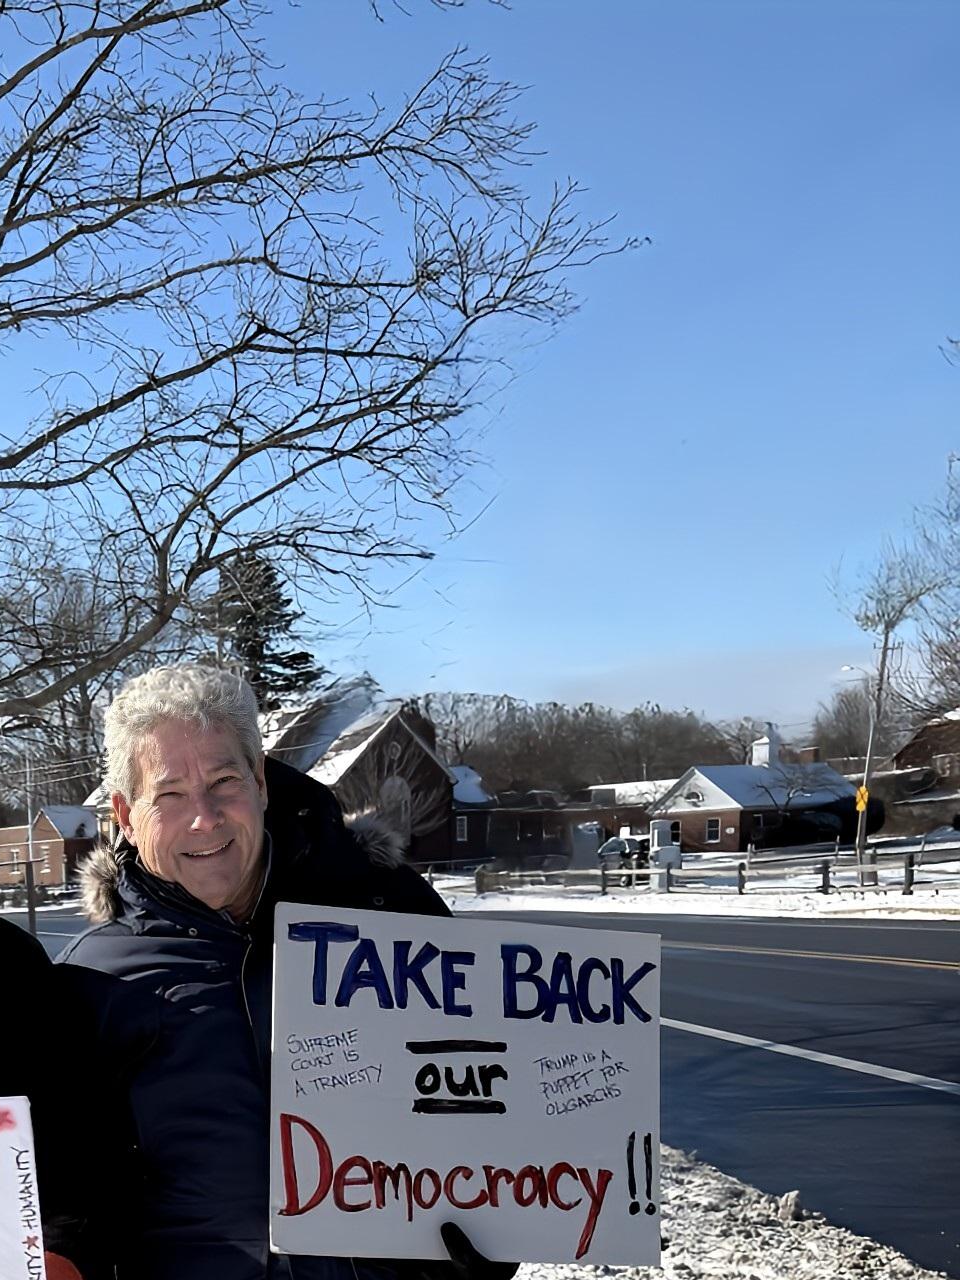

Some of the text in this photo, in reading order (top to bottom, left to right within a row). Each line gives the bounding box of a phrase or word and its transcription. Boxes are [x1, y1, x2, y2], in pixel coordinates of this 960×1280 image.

[288, 921, 657, 1024] TAKE BACK
[287, 1028, 359, 1054] SUPREME
[290, 1049, 360, 1072] COURT IS
[532, 1053, 578, 1078] TRUMP
[601, 1048, 613, 1064] A
[295, 1063, 382, 1099] A TRAVESTY
[414, 1062, 509, 1098] our
[540, 1061, 630, 1101] PUPPET FOR
[546, 1083, 622, 1116] OLIGARCHS
[10, 1145, 39, 1230] HUMANITY
